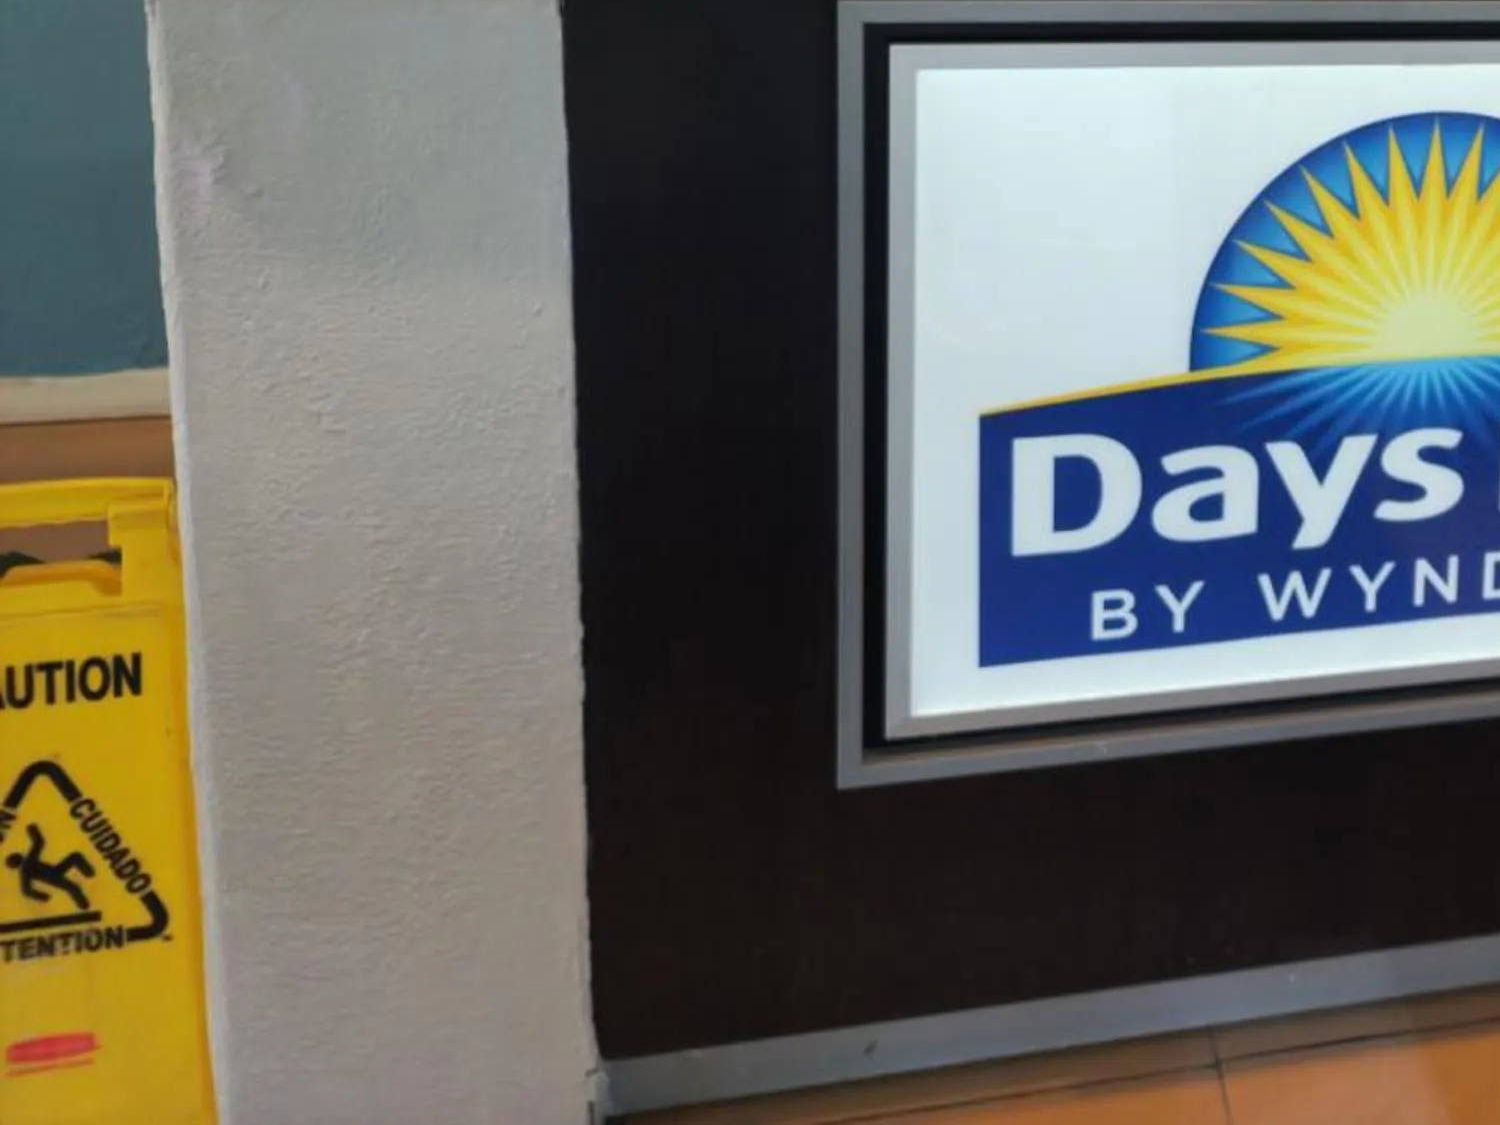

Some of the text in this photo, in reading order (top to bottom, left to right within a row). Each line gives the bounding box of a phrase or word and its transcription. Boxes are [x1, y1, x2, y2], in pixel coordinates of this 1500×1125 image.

[1010, 427, 1464, 558] Days
[1090, 580, 1205, 642] BY
[0, 650, 142, 710] UTION
[69, 797, 153, 895] CUIDADO
